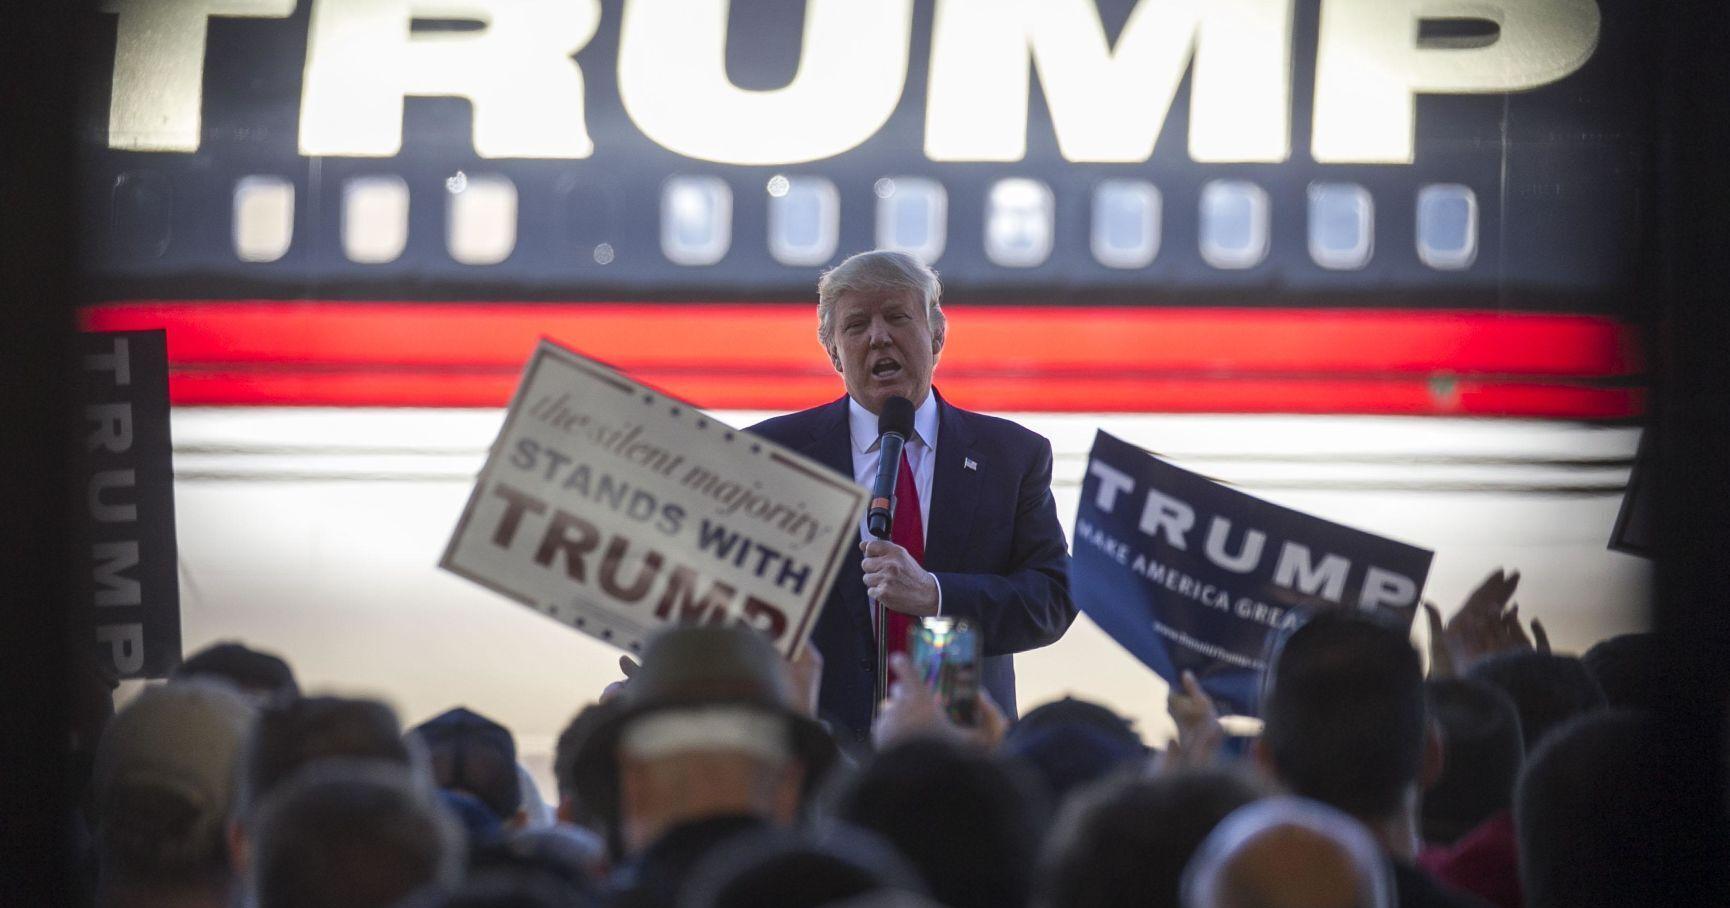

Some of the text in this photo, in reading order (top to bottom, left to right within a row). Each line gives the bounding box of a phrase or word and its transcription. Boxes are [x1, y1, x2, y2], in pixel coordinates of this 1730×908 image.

[103, 0, 1601, 166] TRUMP
[82, 337, 145, 677] TRUMP
[510, 437, 813, 595] STANDS WITH
[527, 391, 821, 548] the silent majority
[1090, 458, 1417, 614] TRUMP
[1077, 518, 1302, 632] MAKE AMERICA GREA
